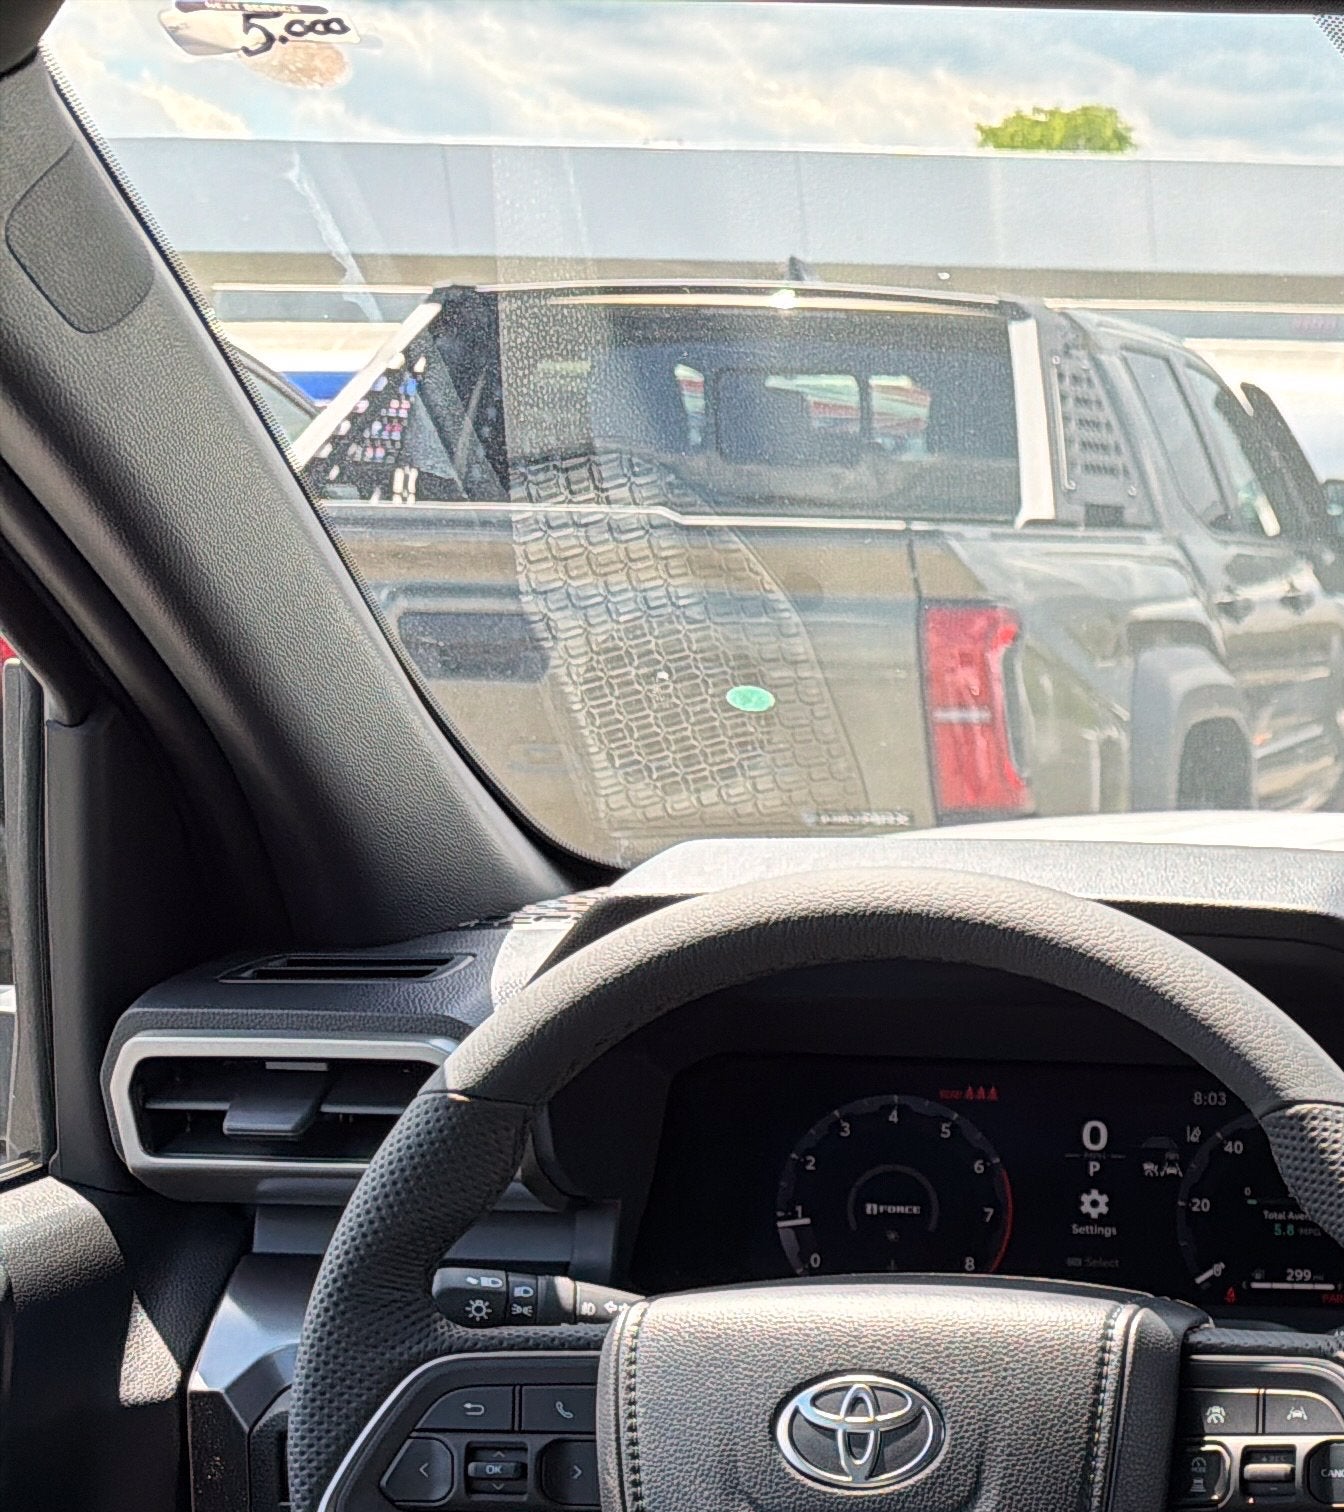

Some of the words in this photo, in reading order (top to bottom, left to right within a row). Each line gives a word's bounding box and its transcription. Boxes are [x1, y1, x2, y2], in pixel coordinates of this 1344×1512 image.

[1193, 1091, 1227, 1106] 8:03
[888, 1110, 898, 1123] 4
[840, 1122, 850, 1137] 3
[940, 1123, 951, 1138] 5
[1082, 1120, 1108, 1151] 0
[1224, 1140, 1243, 1155] 40
[805, 1156, 816, 1170] 2
[974, 1160, 984, 1174] 6
[1088, 1161, 1101, 1177] P
[1191, 1198, 1211, 1213] 20
[983, 1207, 994, 1223] 7
[1072, 1224, 1117, 1238] Settings
[1273, 1223, 1295, 1236] 5.8
[810, 1253, 821, 1268] 0
[964, 1256, 975, 1271] 8
[1286, 1268, 1312, 1281] 299
[485, 1464, 502, 1475] OK
